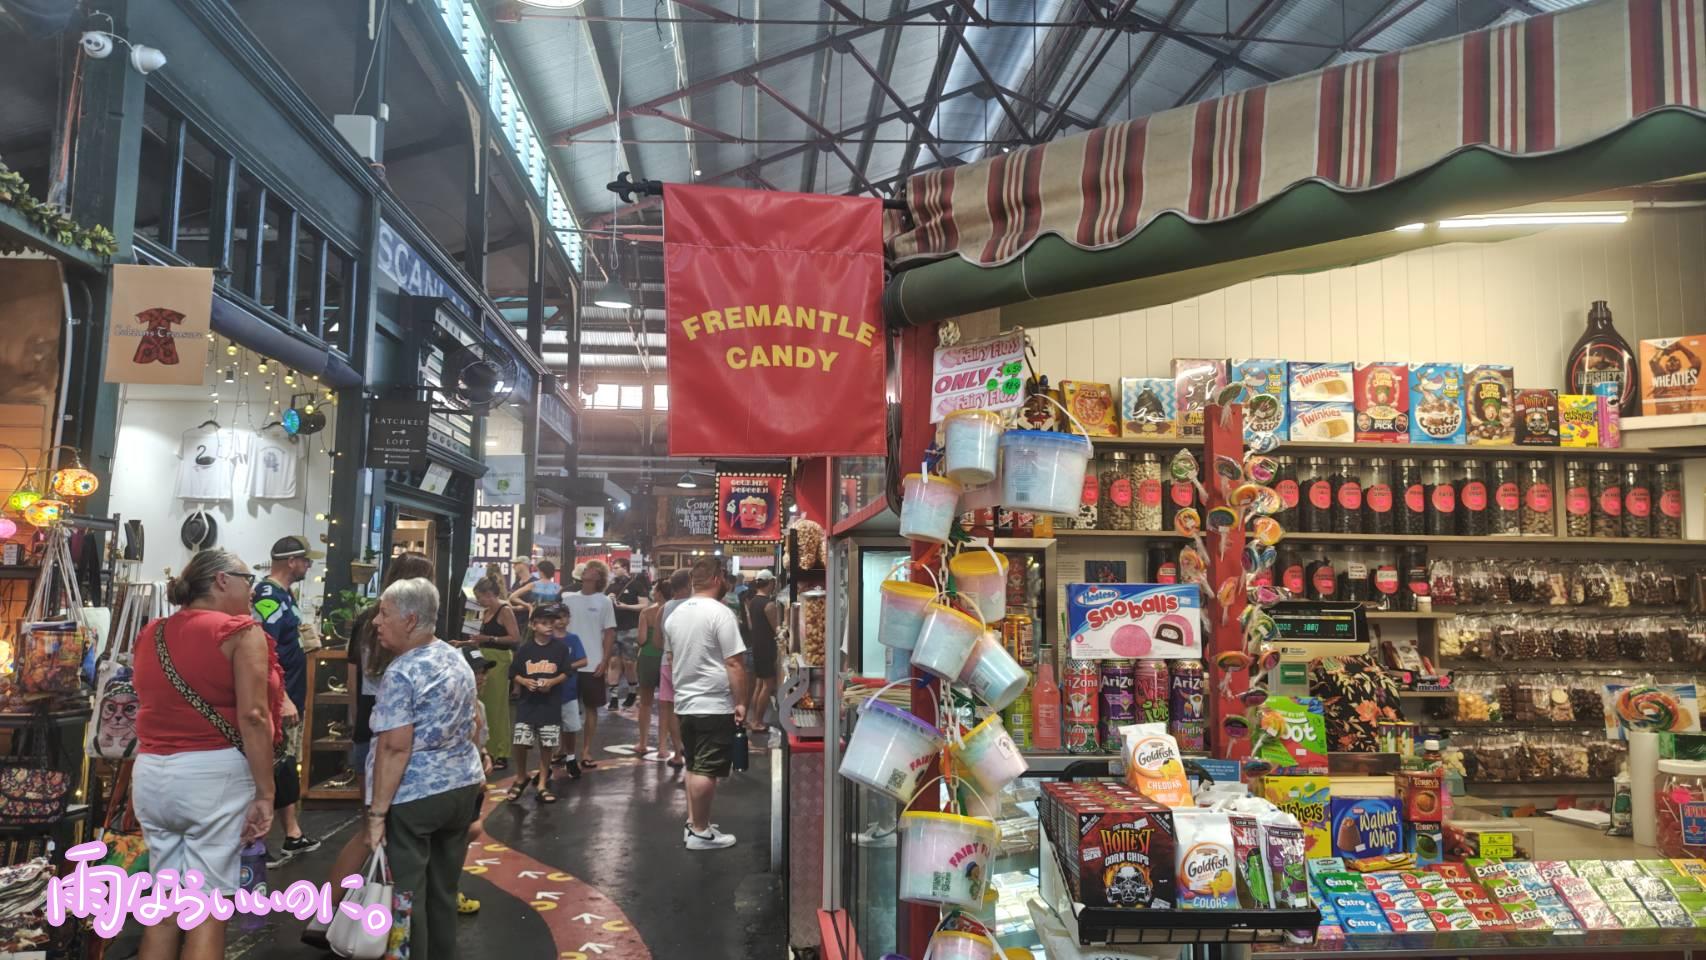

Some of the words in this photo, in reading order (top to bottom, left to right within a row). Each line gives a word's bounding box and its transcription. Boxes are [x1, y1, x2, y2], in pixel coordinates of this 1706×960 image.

[681, 304, 877, 348] FREMANTLE
[726, 344, 838, 372] CANDY
[959, 345, 990, 363] Fairy
[934, 366, 994, 394] ONLY
[1295, 368, 1340, 387] Twinkies
[1576, 371, 1626, 385] HERSHEY'S
[1652, 369, 1698, 388] WHEATIES
[374, 416, 425, 426] LATCHKEY
[1298, 408, 1341, 428] Twinkies
[475, 510, 512, 529] UDGE
[474, 533, 511, 558] REE
[261, 584, 273, 597] 3
[1080, 590, 1118, 604] Hostess
[1282, 722, 1317, 743] oot
[1138, 746, 1176, 766] Goldfish
[1146, 780, 1183, 790] CHEDDAR
[1277, 802, 1324, 824] ushers
[1359, 806, 1399, 832] Walnut
[1100, 828, 1155, 857] HOTTEST
[1369, 828, 1397, 849] Whip
[949, 842, 979, 868] FAIRY
[1105, 852, 1125, 867] CORN
[1126, 851, 1150, 866] CHIPS
[1187, 855, 1229, 878] Goldfish
[1475, 861, 1504, 878] Extra
[1325, 877, 1354, 888] extra
[1494, 884, 1524, 899] Extra
[1193, 897, 1229, 909] COLORS
[1336, 897, 1366, 908] extra
[1346, 918, 1377, 929] extra
[1511, 909, 1543, 924] Extra
